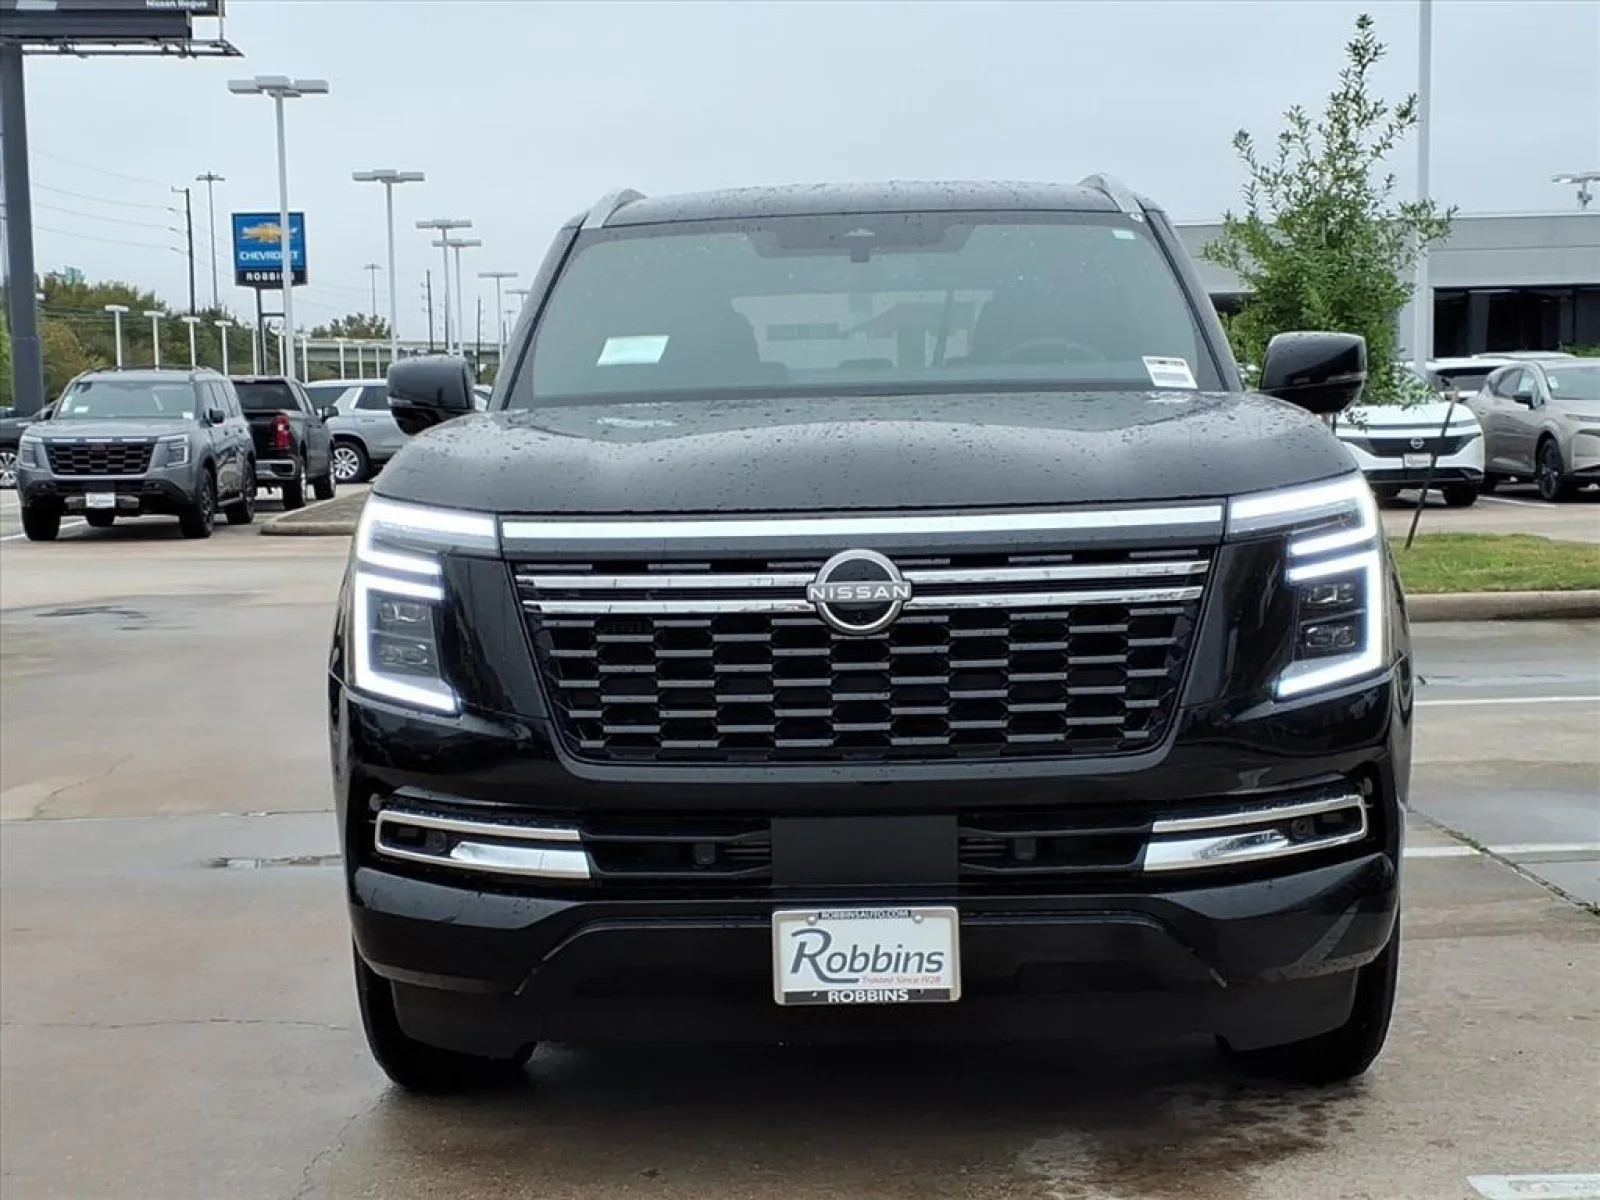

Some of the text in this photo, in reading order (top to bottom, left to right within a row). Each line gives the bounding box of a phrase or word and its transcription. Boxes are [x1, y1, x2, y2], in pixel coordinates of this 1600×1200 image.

[240, 251, 298, 260] CHEVROT
[246, 272, 295, 281] ROBBI
[810, 585, 909, 600] NISSAN
[791, 928, 944, 983] Robbins
[827, 989, 909, 1003] ROBBINS
